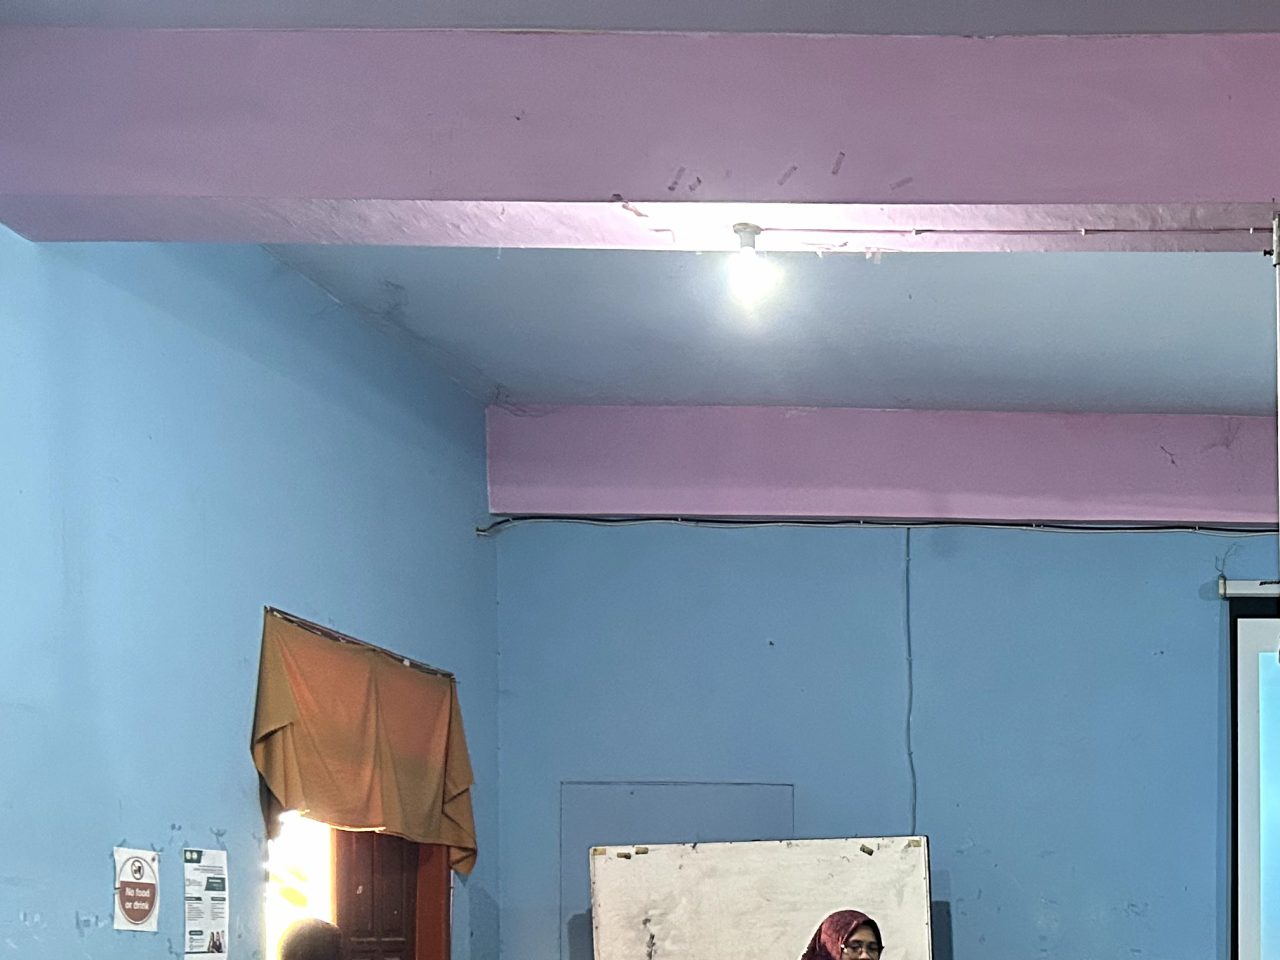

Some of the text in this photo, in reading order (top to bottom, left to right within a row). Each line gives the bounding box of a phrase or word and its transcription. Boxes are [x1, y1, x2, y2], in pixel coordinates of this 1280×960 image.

[125, 887, 151, 898] No food
[133, 901, 149, 911] drink
